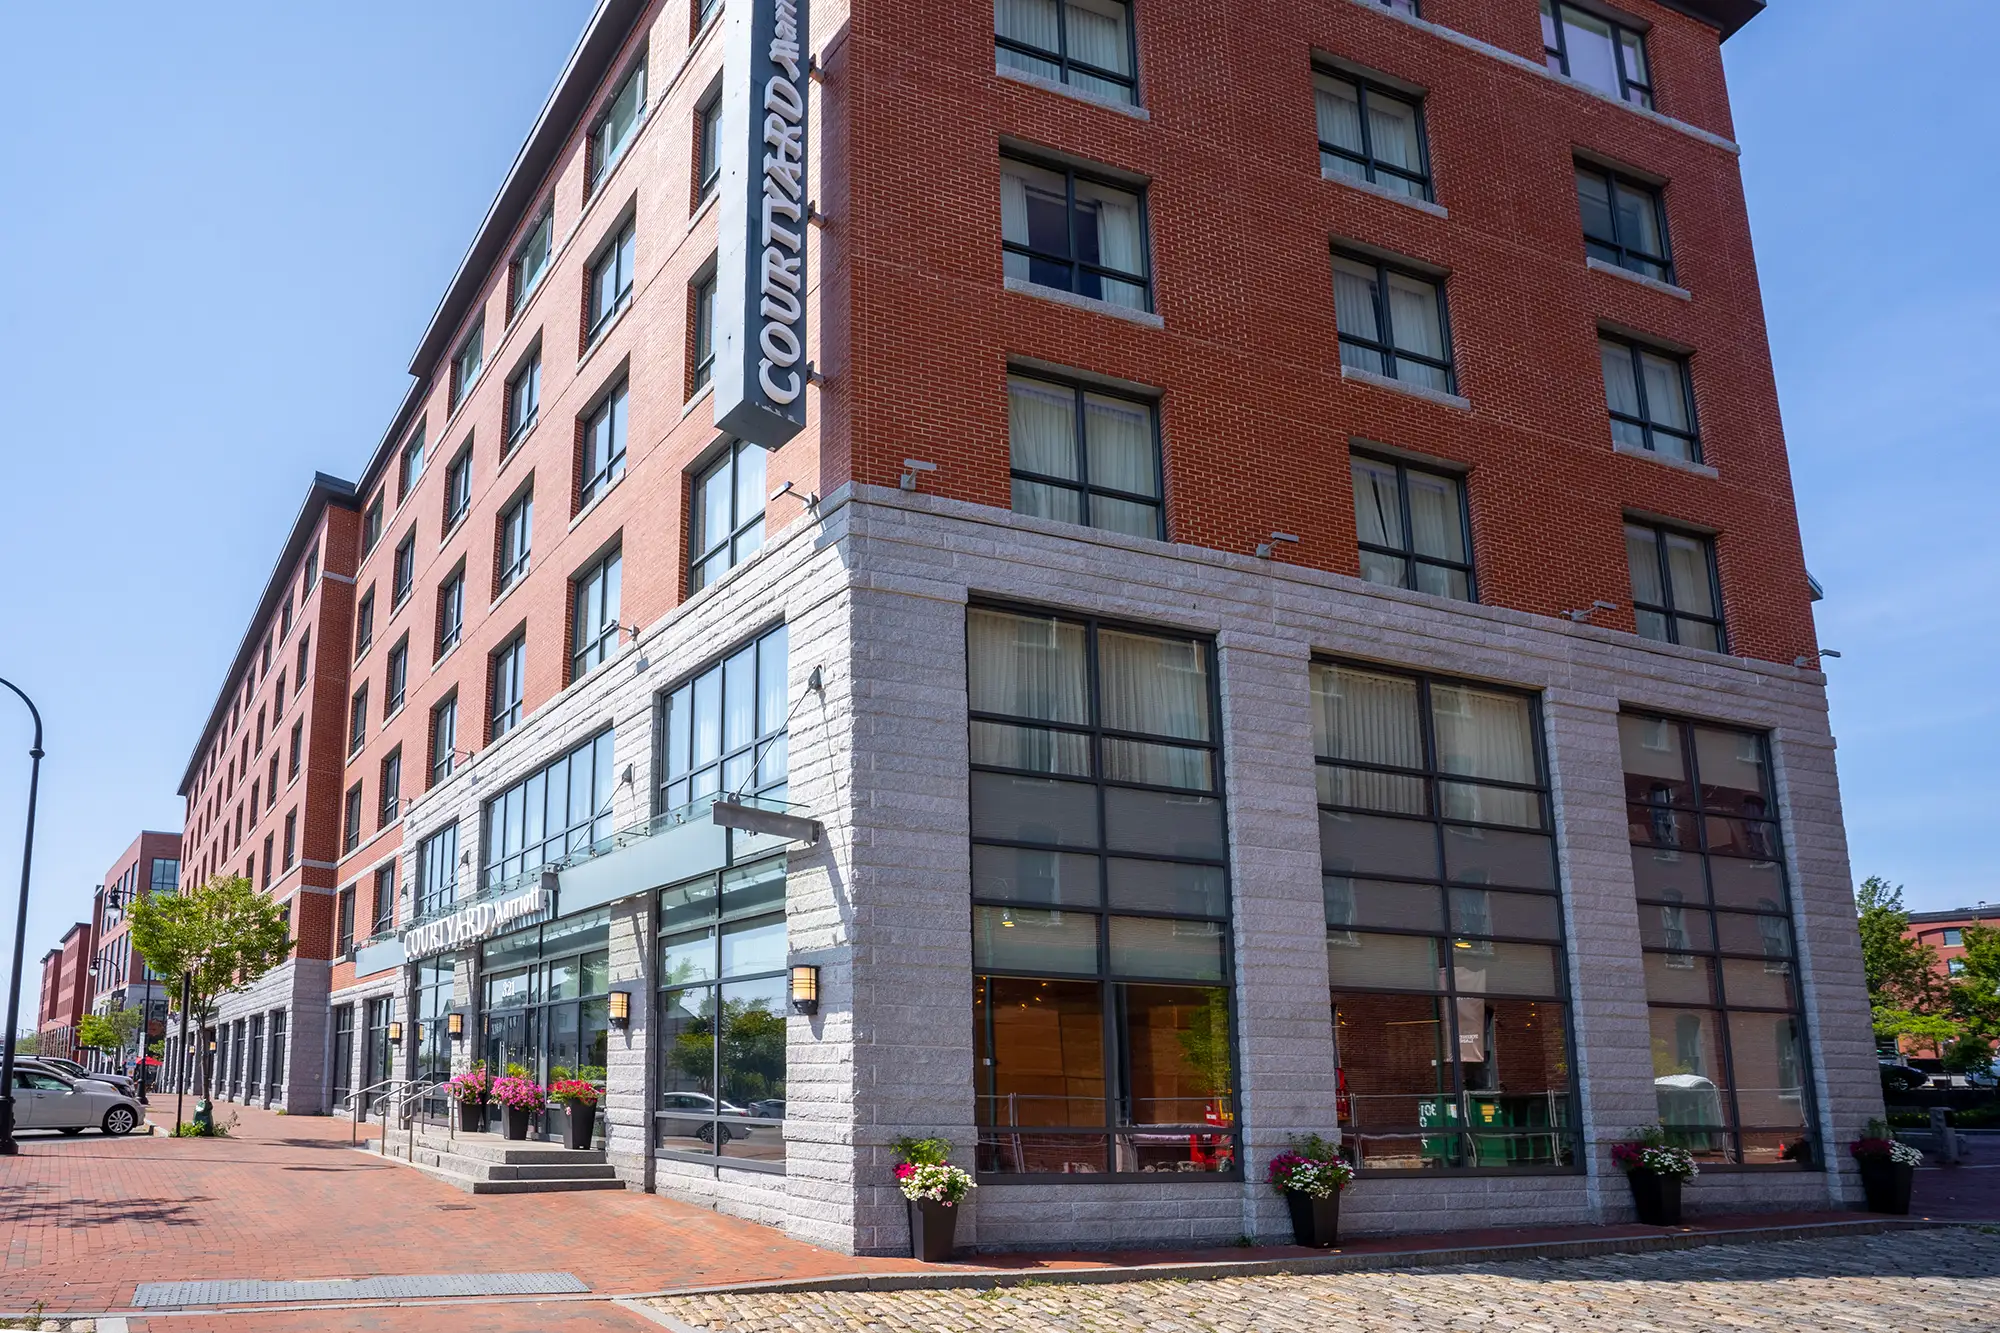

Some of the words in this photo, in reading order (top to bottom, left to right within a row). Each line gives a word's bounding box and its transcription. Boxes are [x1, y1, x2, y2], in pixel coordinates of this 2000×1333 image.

[768, 0, 801, 83] Marr
[758, 75, 804, 405] COURTYARD
[403, 902, 493, 958] COURTYARD
[491, 885, 542, 927] Marriott
[502, 981, 515, 997] 321
